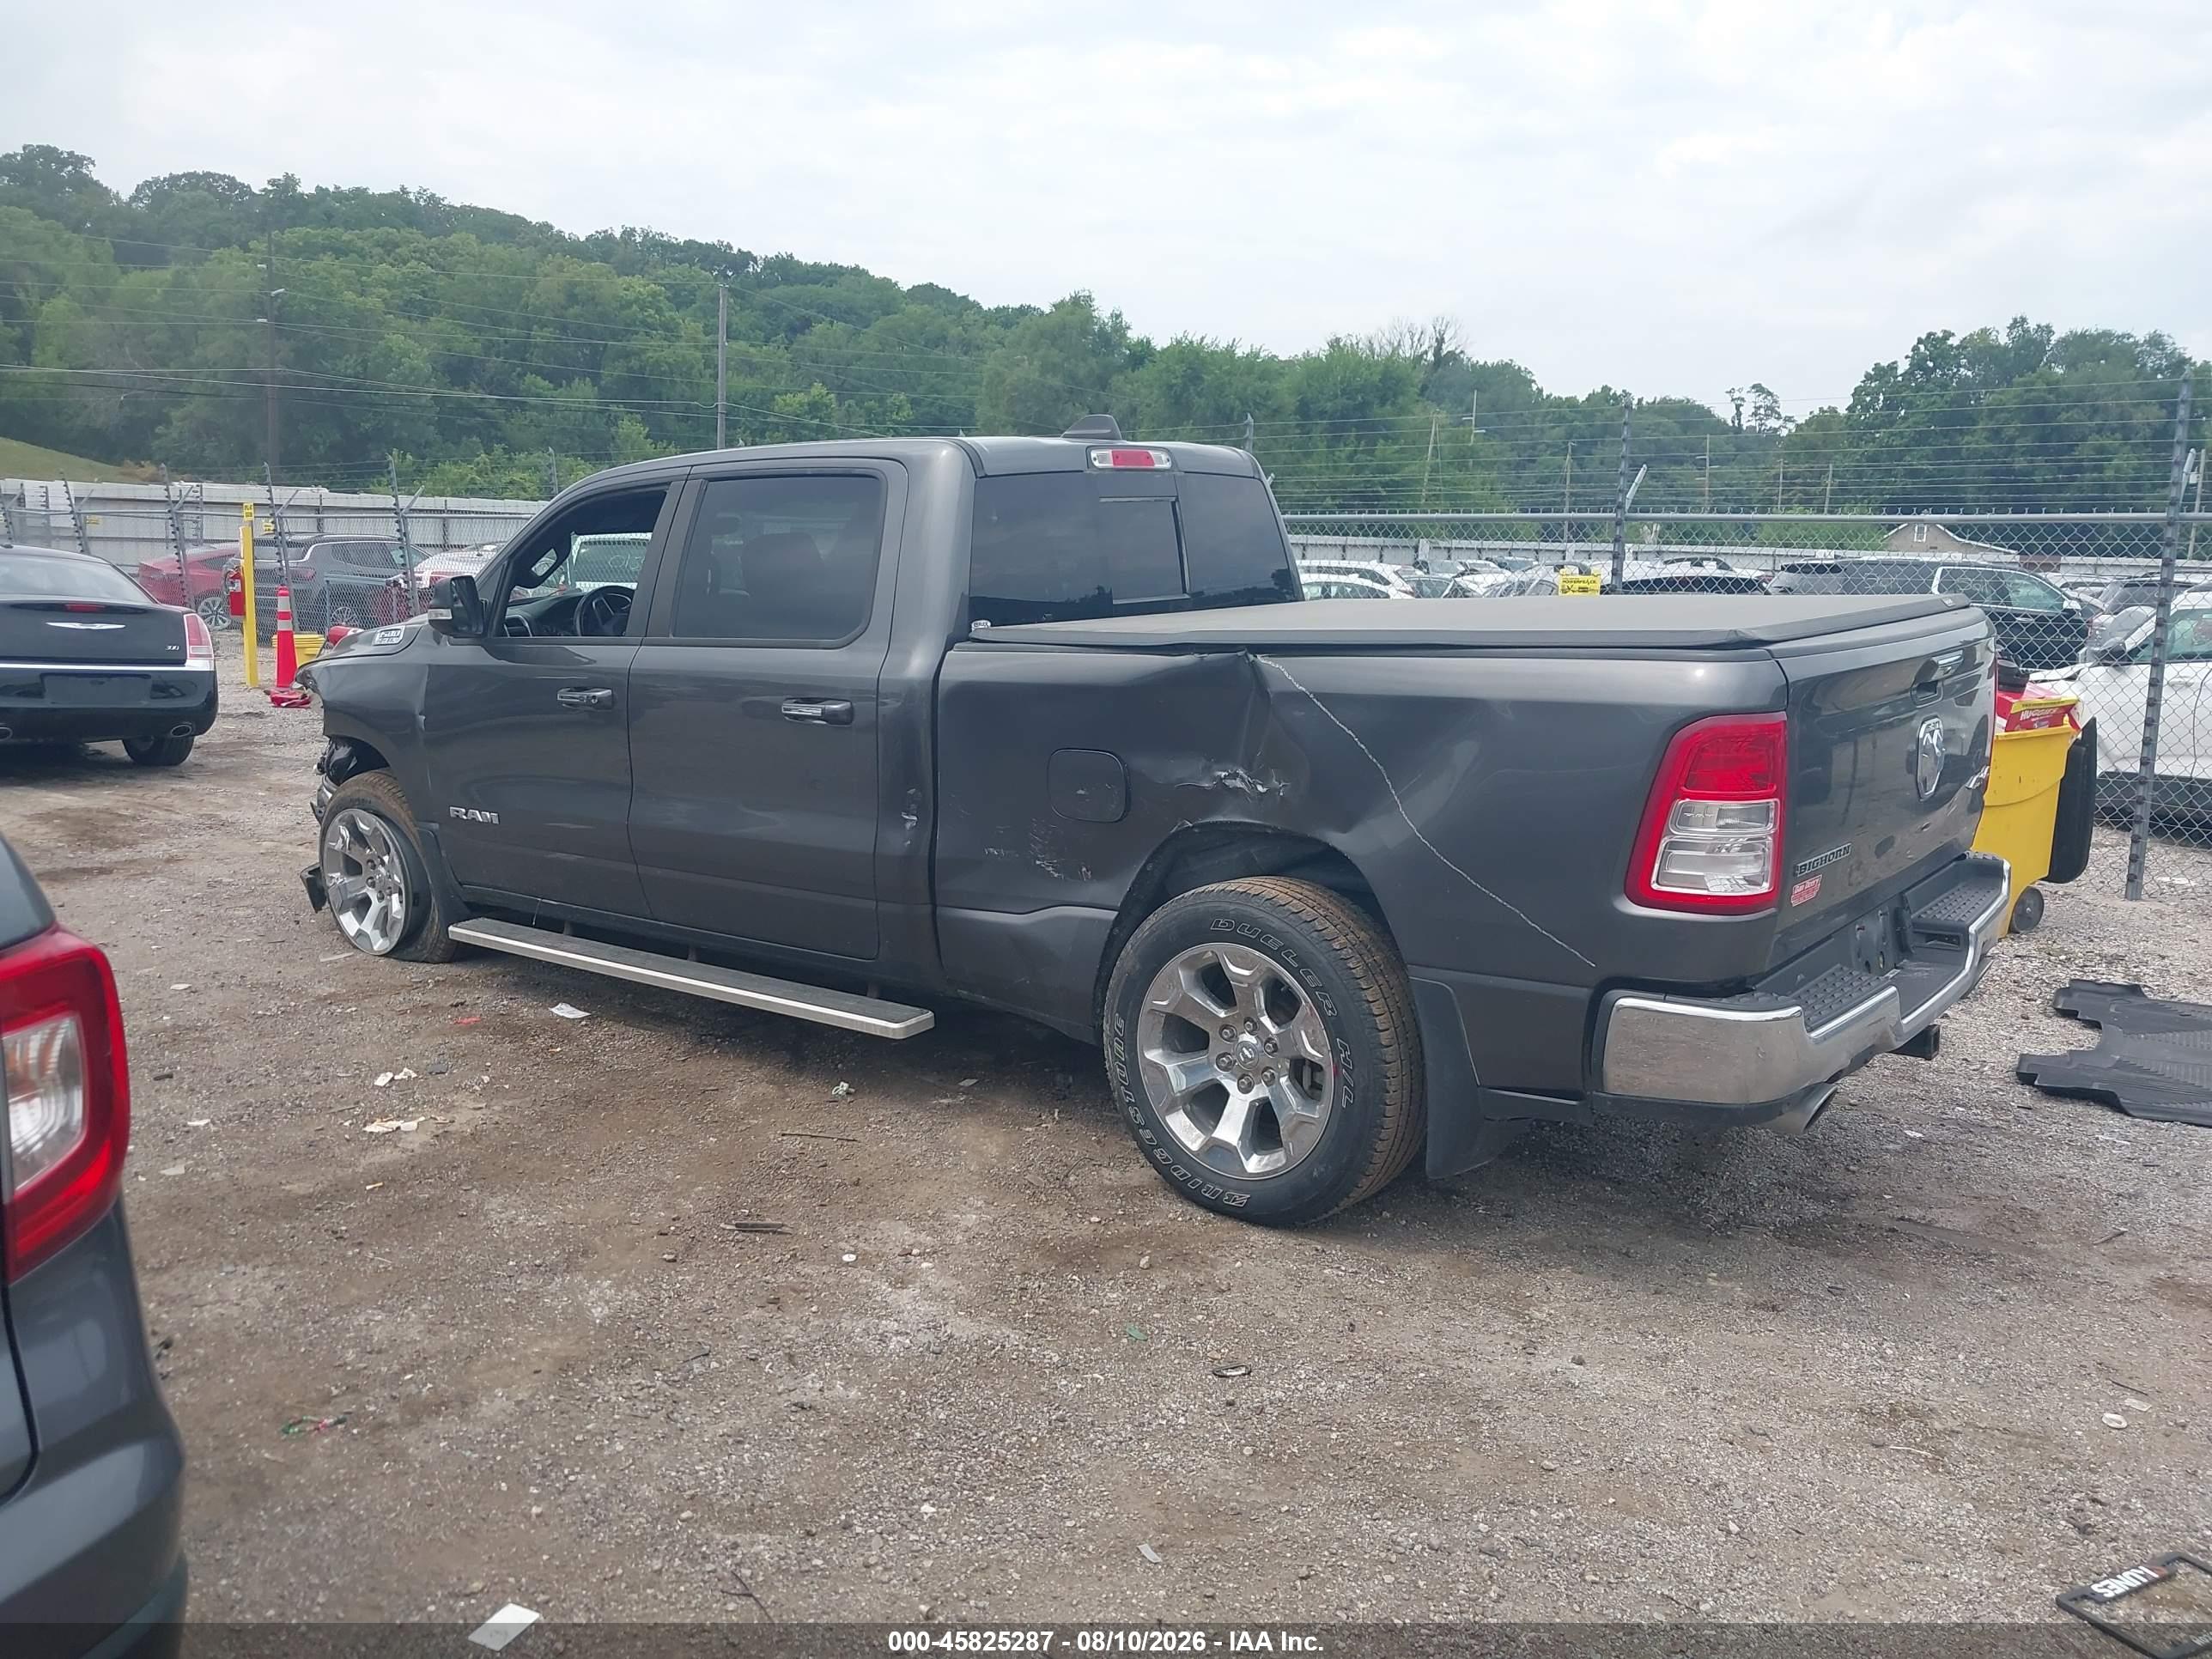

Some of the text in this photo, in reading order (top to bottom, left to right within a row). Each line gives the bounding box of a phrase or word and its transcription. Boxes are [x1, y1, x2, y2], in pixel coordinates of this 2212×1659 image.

[449, 806, 500, 824] RAM
[1798, 844, 1850, 875] BIGHORN
[1210, 918, 1355, 1109] DUELER H/L
[1114, 1012, 1251, 1207] BRIDGESTONE
